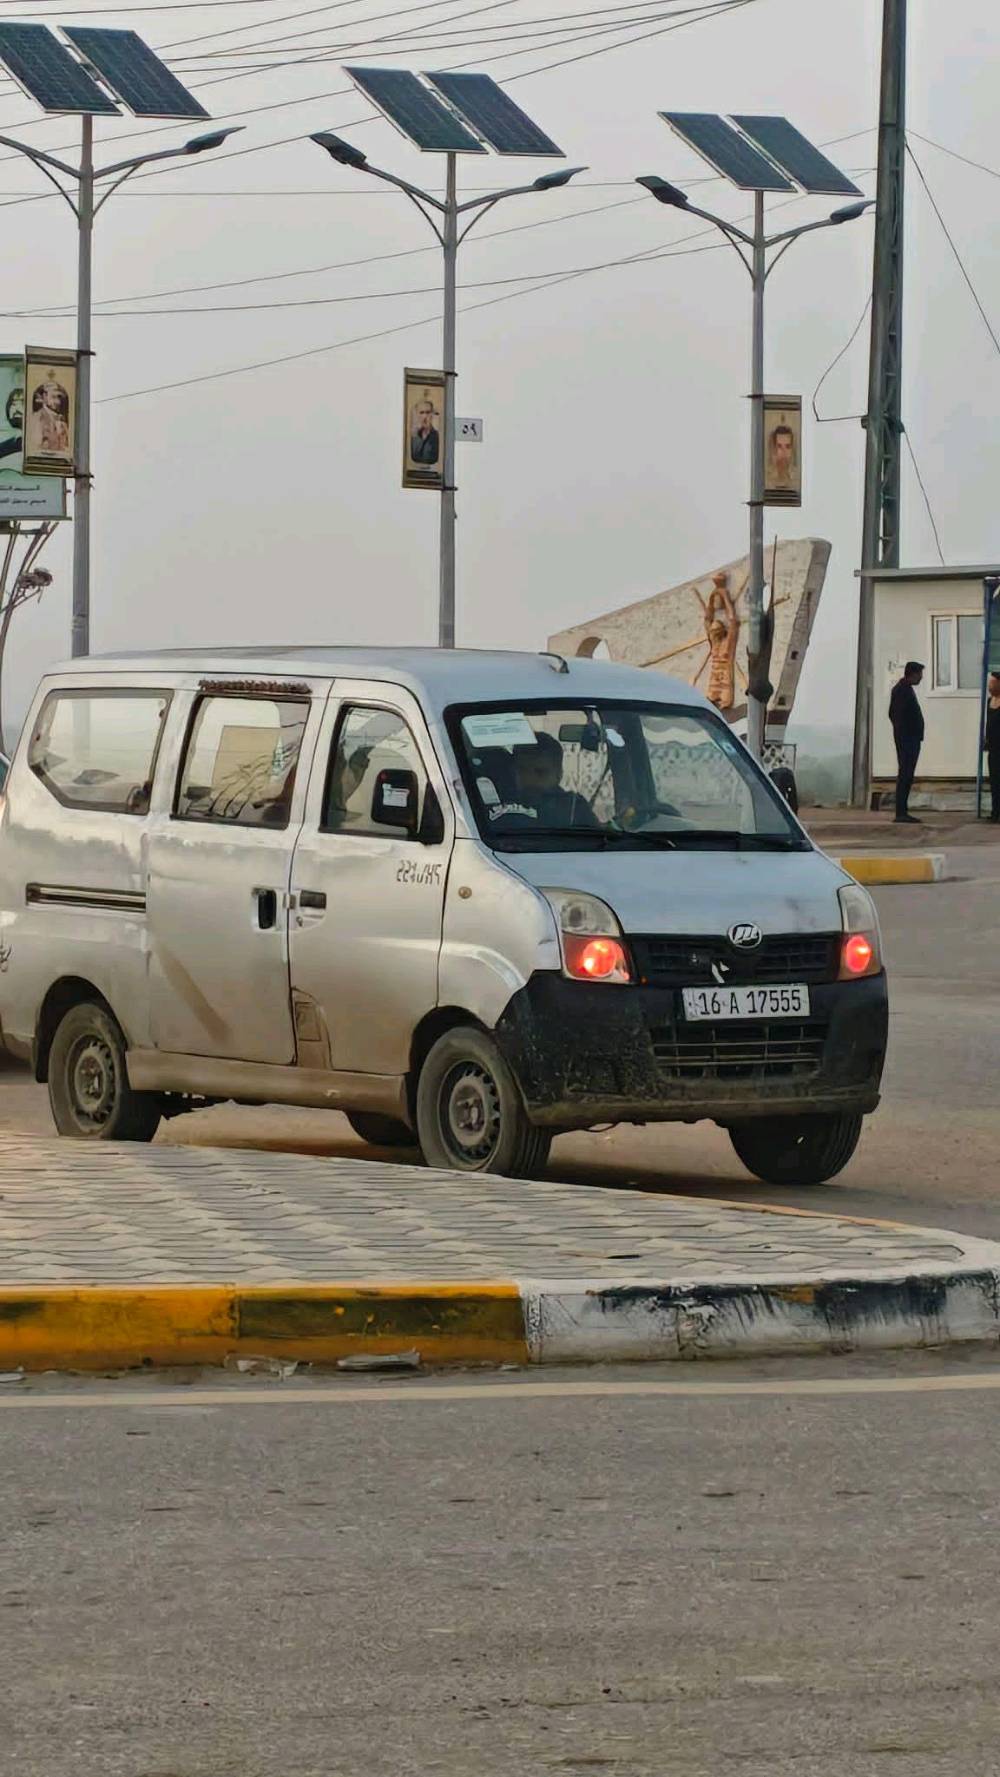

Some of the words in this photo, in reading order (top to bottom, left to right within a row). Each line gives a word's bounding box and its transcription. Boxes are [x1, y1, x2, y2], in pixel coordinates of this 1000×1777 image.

[699, 992, 720, 1015] 16
[730, 992, 740, 1014] A
[746, 989, 801, 1014] 17555
